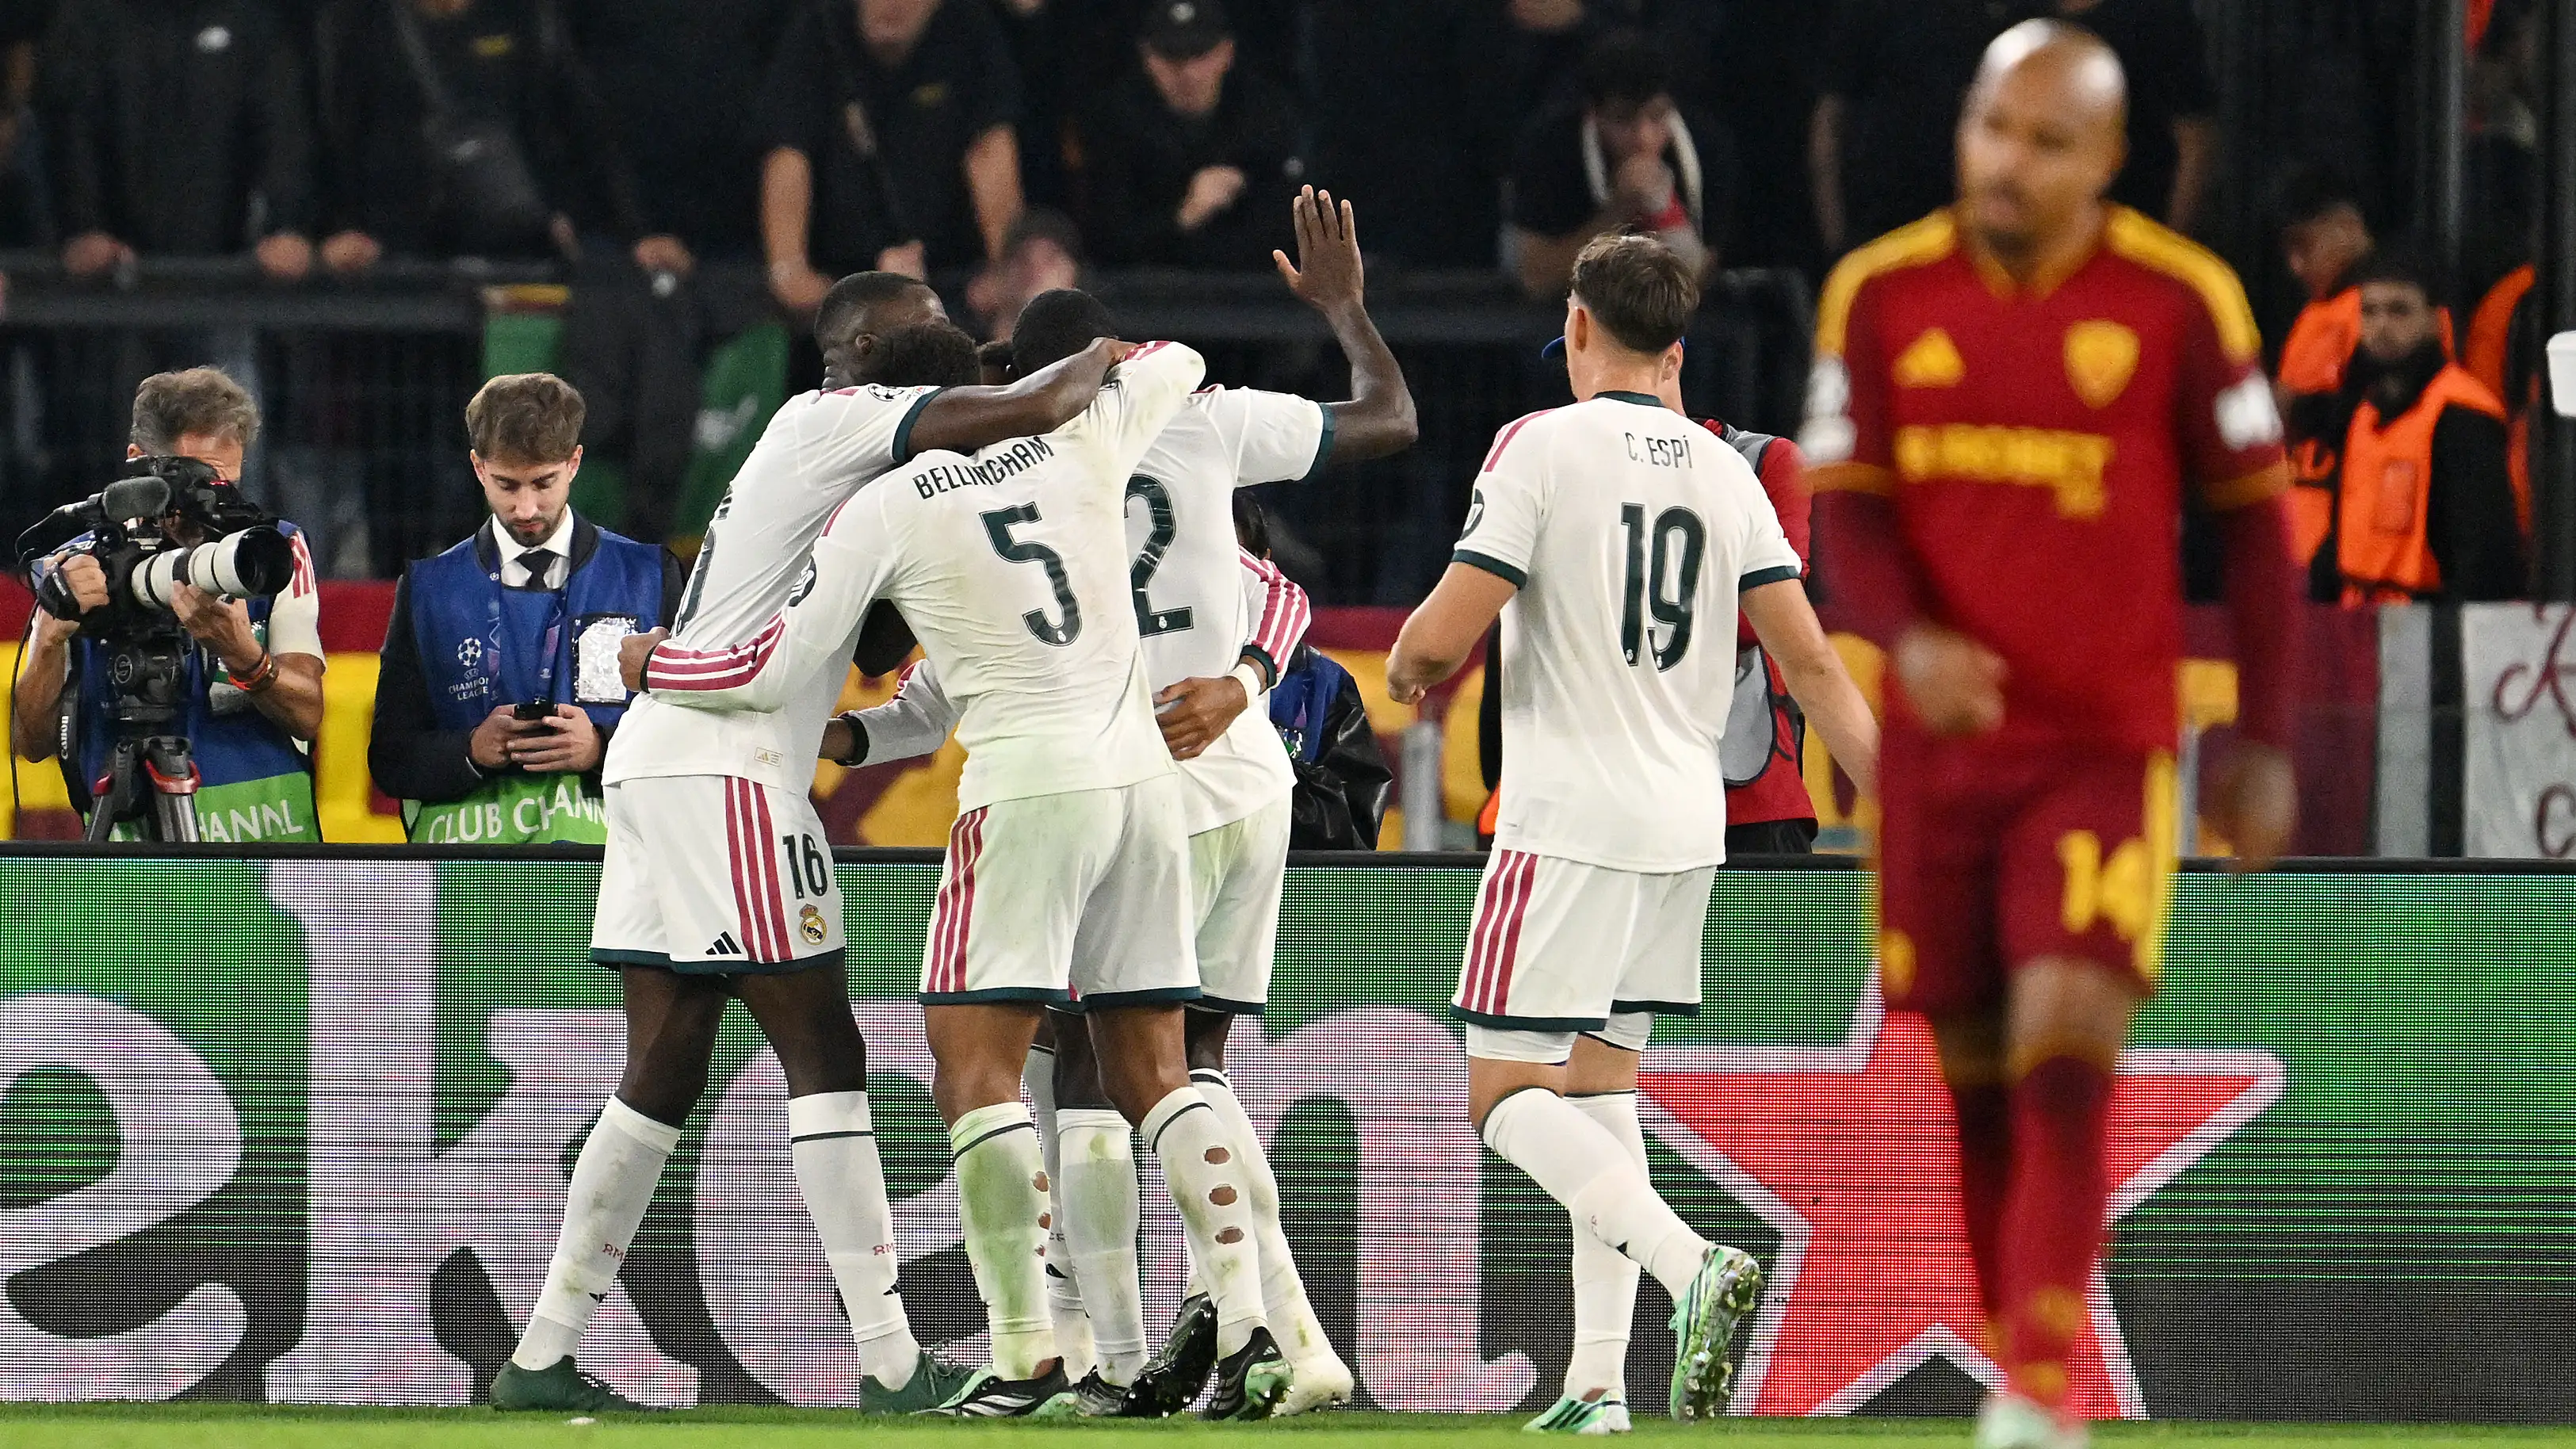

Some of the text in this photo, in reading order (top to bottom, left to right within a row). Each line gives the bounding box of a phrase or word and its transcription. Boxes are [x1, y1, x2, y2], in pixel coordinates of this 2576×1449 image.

[912, 435, 1055, 499] BELLINGHAM
[1625, 432, 1693, 468] C. ESPÍ
[978, 501, 1083, 647] 5
[1621, 501, 1707, 673] 19
[60, 715, 69, 760] Canon
[428, 783, 609, 843] CLUB CHANN
[782, 833, 828, 900] 16
